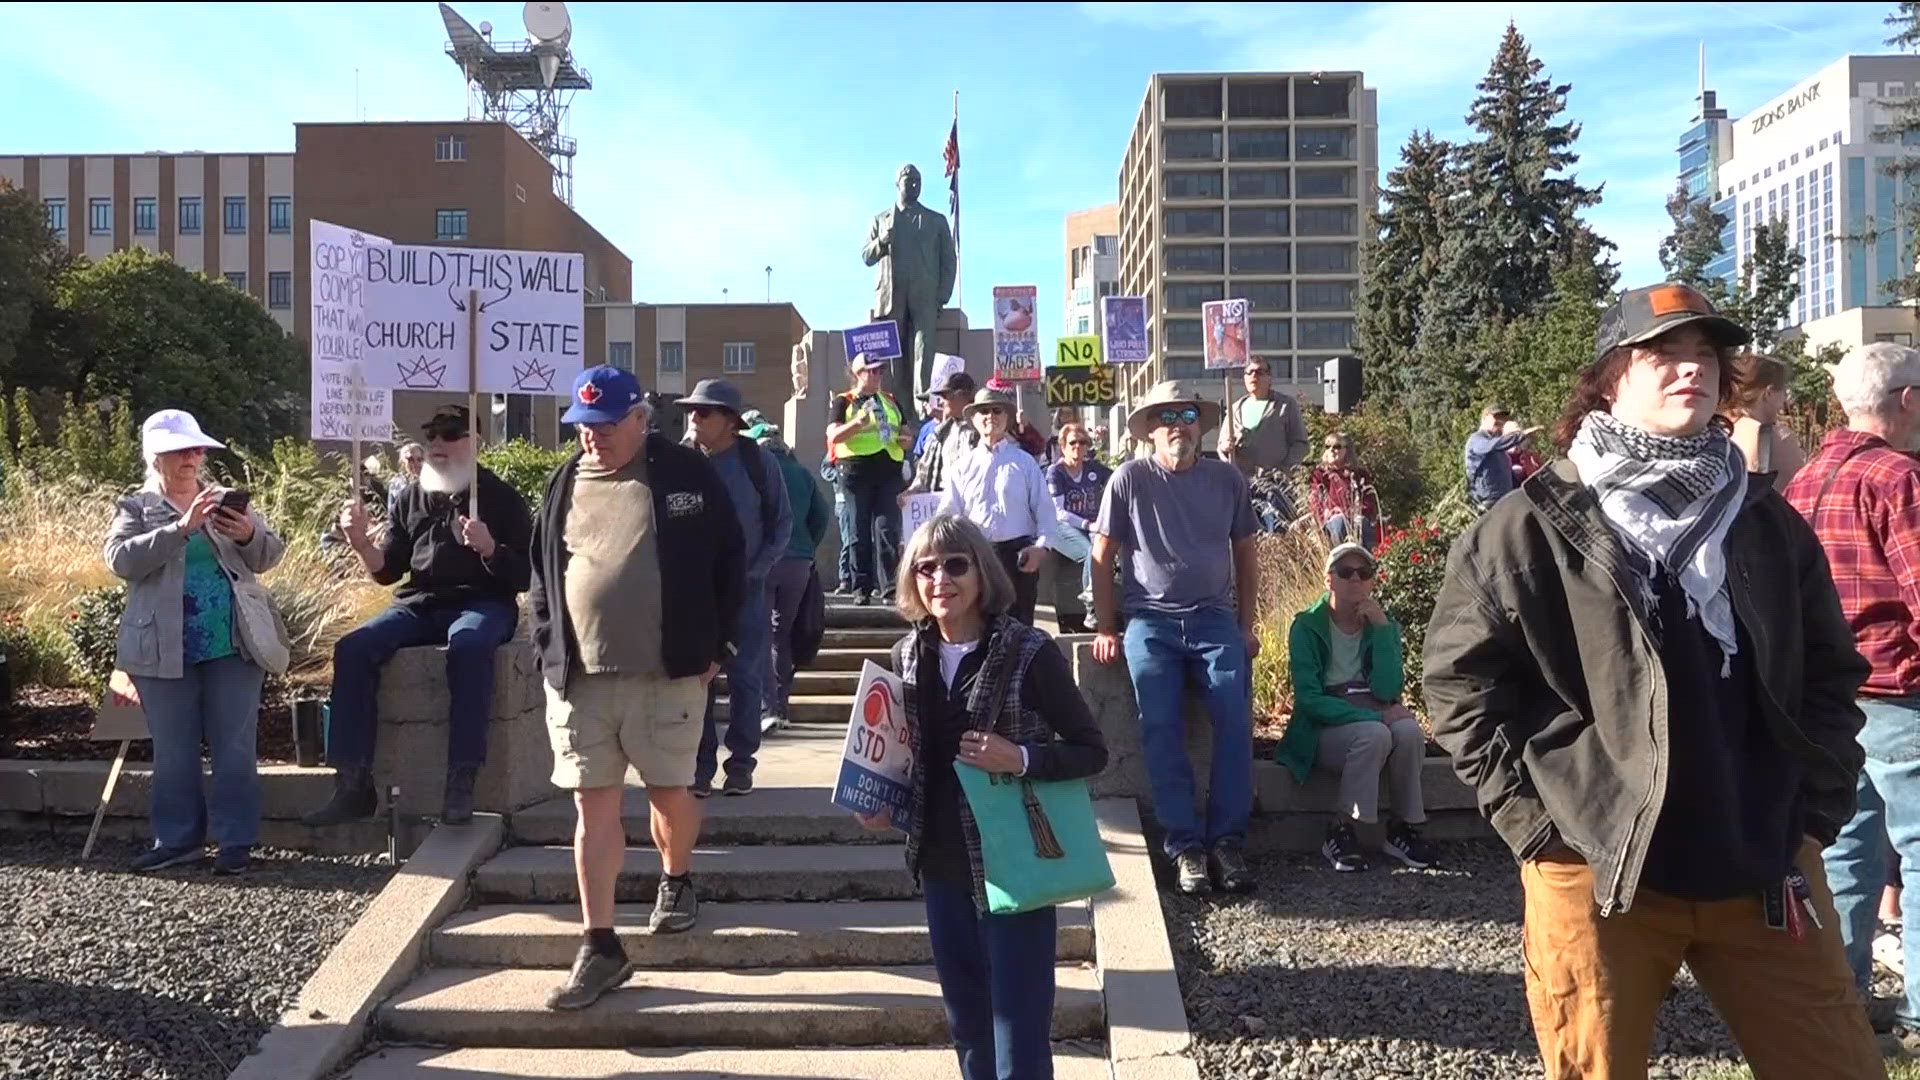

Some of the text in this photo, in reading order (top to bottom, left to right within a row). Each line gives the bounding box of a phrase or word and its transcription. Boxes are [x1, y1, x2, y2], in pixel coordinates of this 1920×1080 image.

[1752, 81, 1821, 134] ZIONS BANK
[367, 248, 579, 293] BUILD THIS WALL
[314, 304, 345, 331] THAT
[316, 333, 345, 357] YOUR
[365, 321, 579, 355] CHURCH STATE
[320, 372, 341, 385] VOTE
[1046, 374, 1114, 404] Kings
[326, 388, 343, 400] LIKE
[853, 725, 886, 763] STD
[858, 773, 889, 799] DON'T
